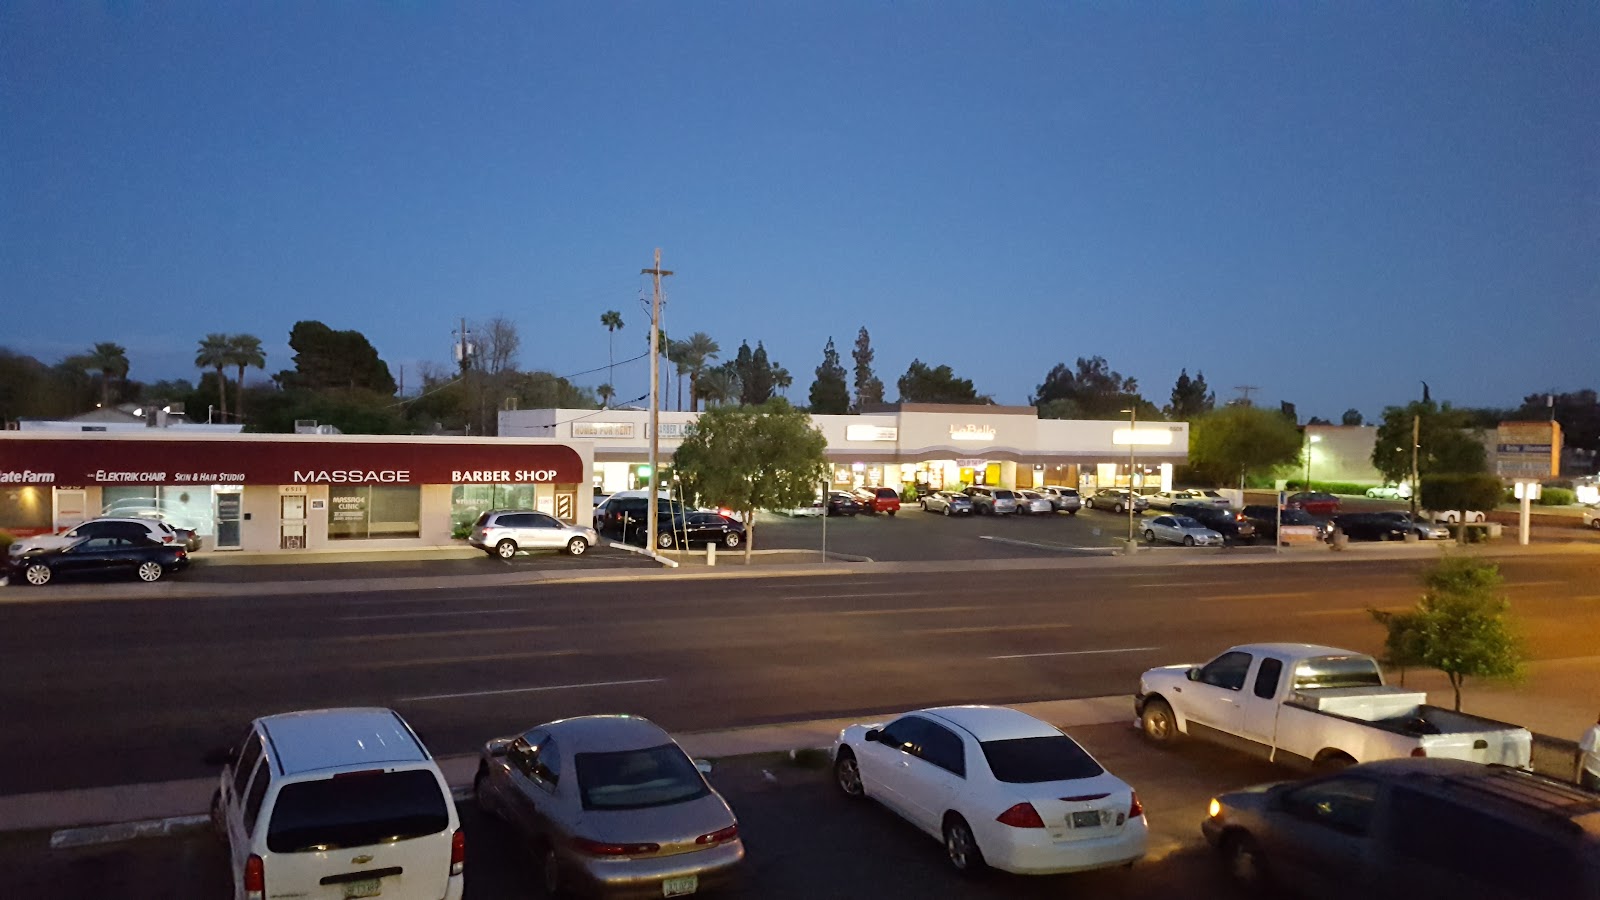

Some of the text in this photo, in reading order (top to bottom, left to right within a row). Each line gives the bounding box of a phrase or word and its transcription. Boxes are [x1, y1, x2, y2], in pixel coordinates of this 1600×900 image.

[22, 470, 55, 483] Farm
[96, 470, 139, 482] ELEKTRIK
[140, 472, 166, 482] CHAIR
[174, 472, 245, 482] SKIN & HAIR STUDIO
[294, 470, 410, 482] MASSAGE
[452, 470, 557, 482] BARBER SHOP
